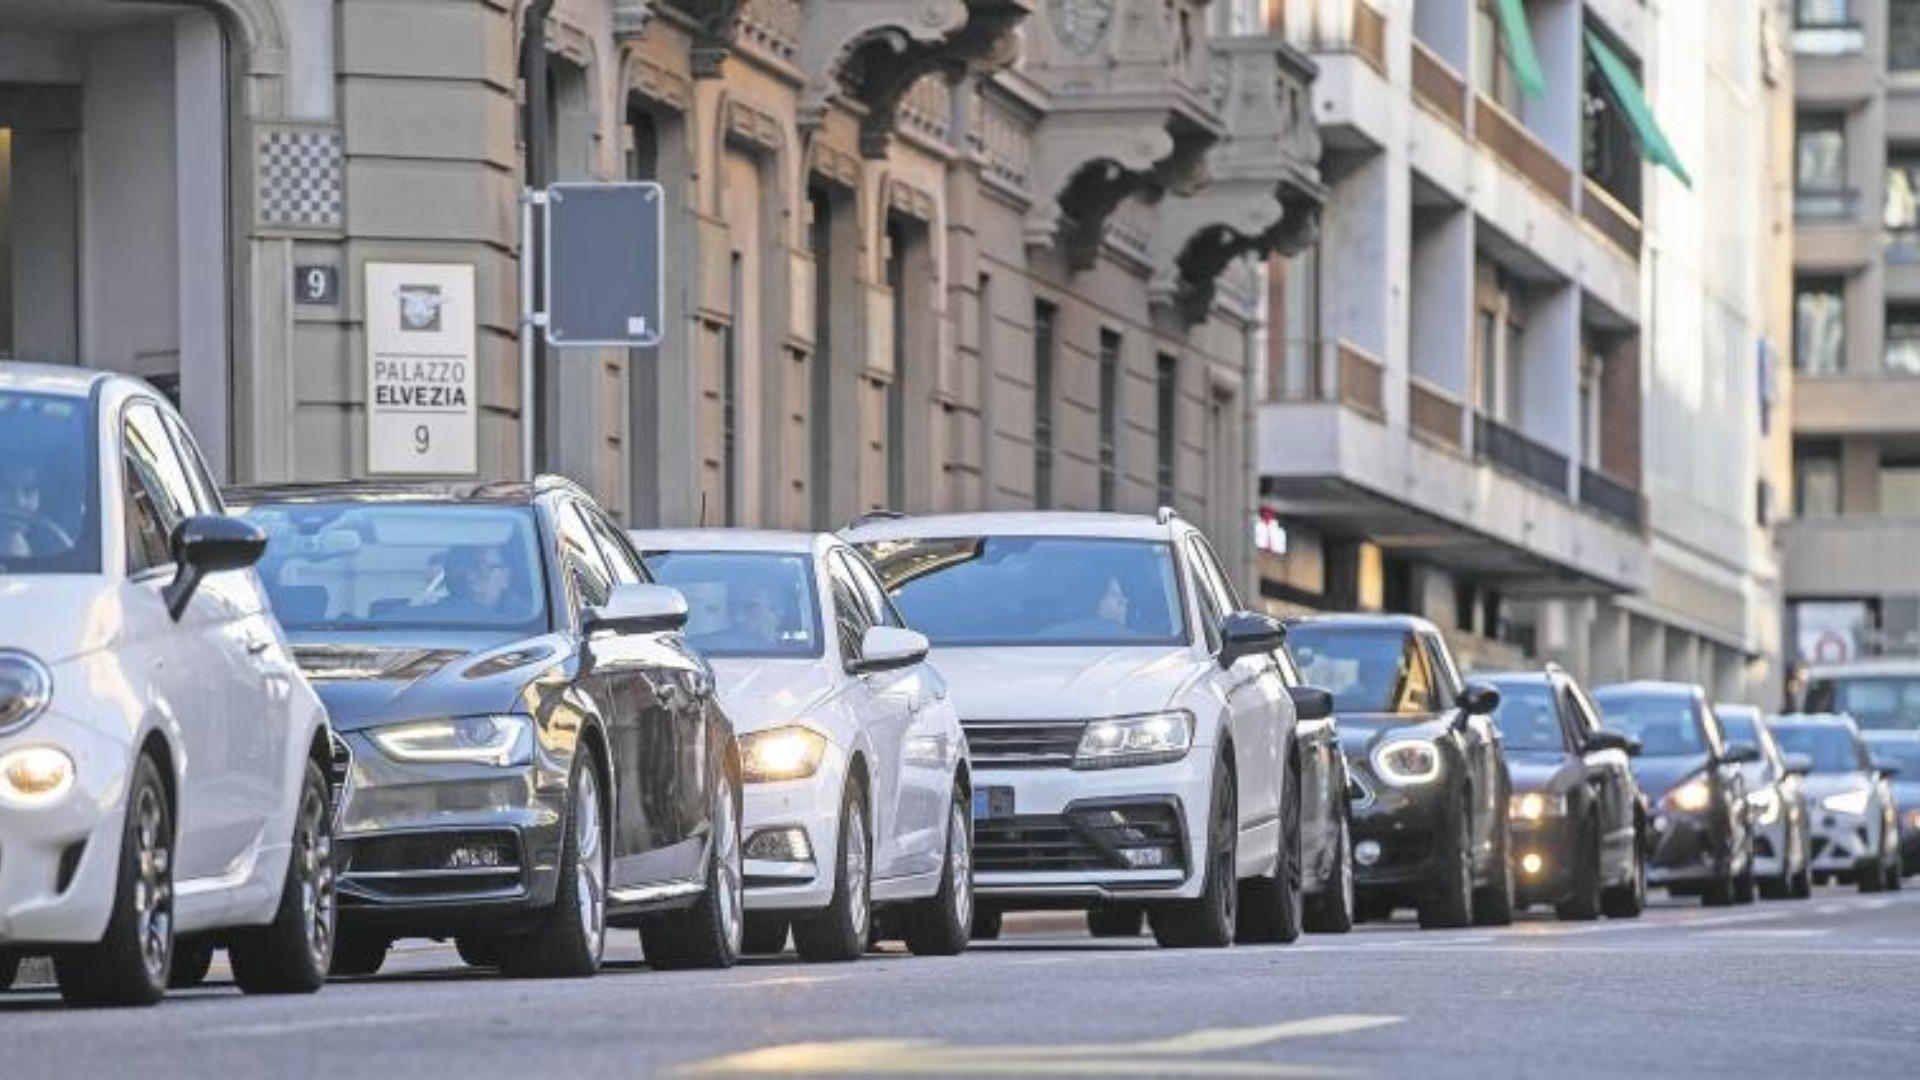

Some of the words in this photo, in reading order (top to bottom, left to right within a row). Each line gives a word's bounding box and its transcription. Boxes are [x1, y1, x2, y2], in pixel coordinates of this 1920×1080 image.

[308, 269, 326, 298] 9
[375, 361, 466, 383] PALAZZO
[375, 385, 467, 406] ELVEZIA
[415, 424, 430, 454] 9
